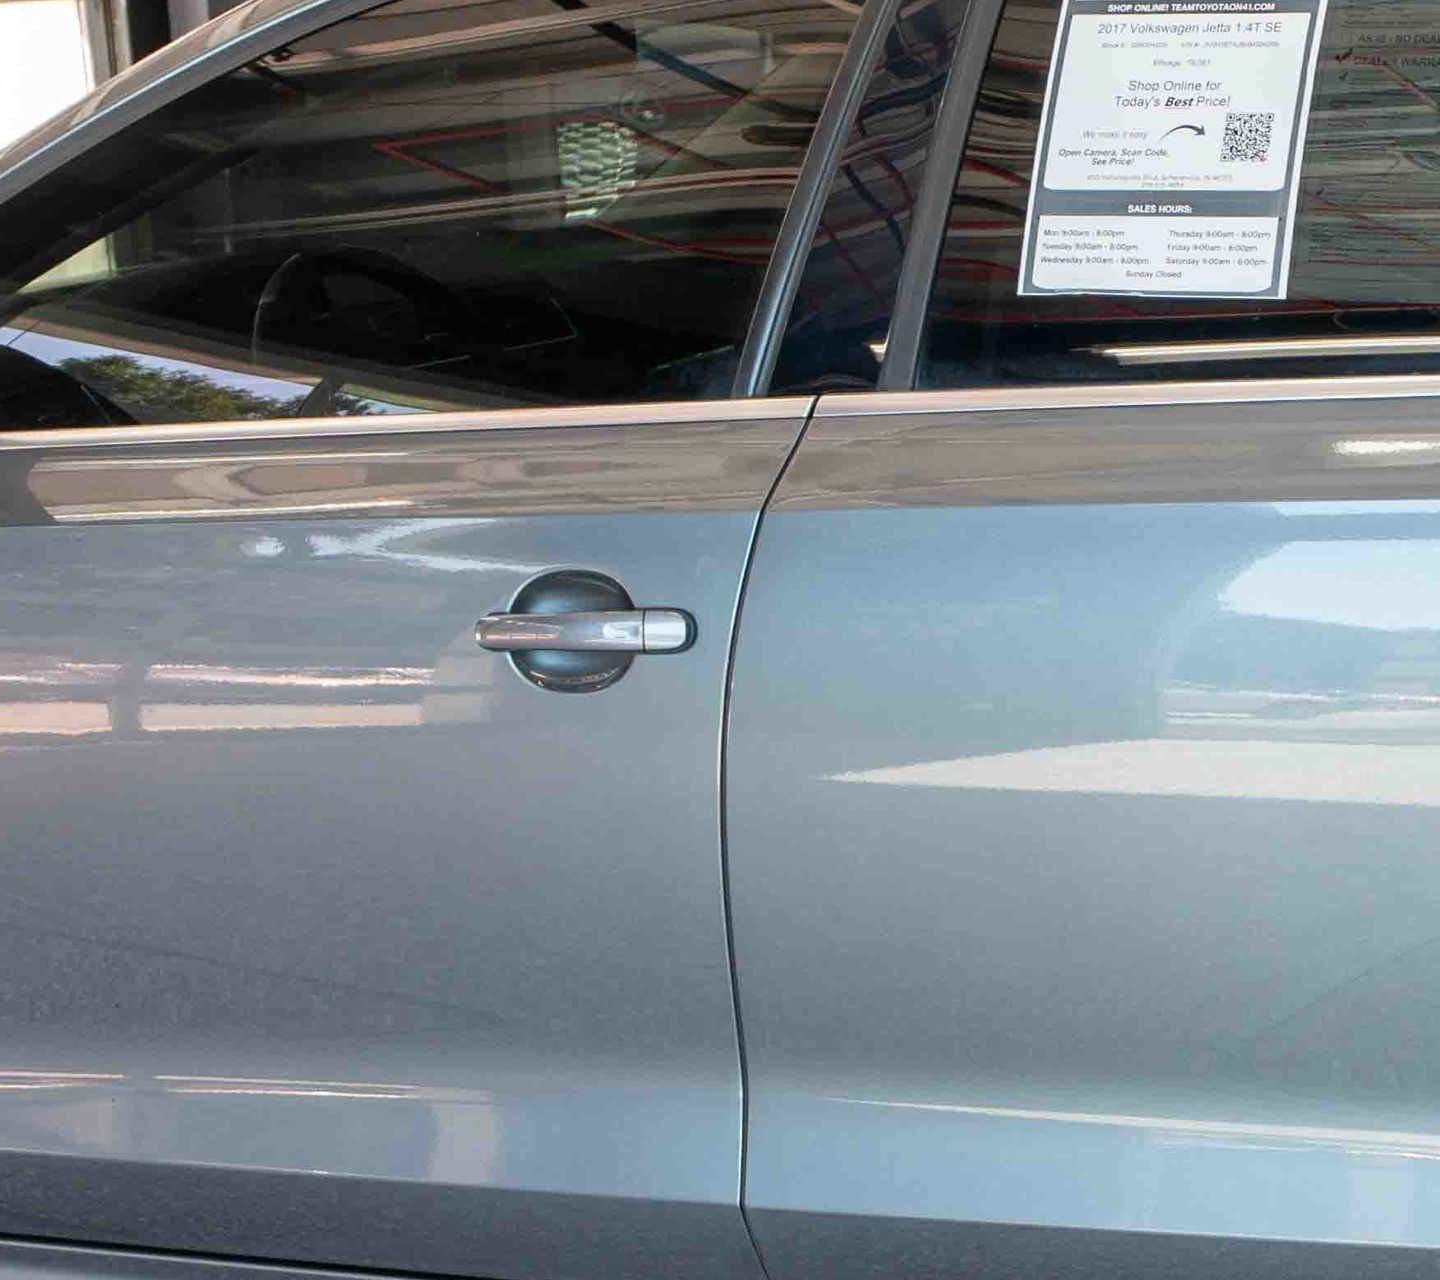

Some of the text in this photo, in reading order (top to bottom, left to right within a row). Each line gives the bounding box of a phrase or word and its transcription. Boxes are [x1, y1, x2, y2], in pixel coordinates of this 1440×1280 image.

[1107, 4, 1133, 13] SHOP
[1134, 3, 1169, 12] ONLINE!
[1097, 23, 1127, 34] 2017
[1130, 23, 1200, 36] Volkswagen
[1202, 22, 1232, 33] Jetta
[1264, 21, 1283, 33] SE
[1127, 80, 1223, 93] Shop Online for
[1115, 95, 1231, 109] Today's Best Price!
[1058, 148, 1082, 158] Open
[1121, 147, 1143, 157] Scan
[1127, 204, 1193, 214] SALES HOURS:
